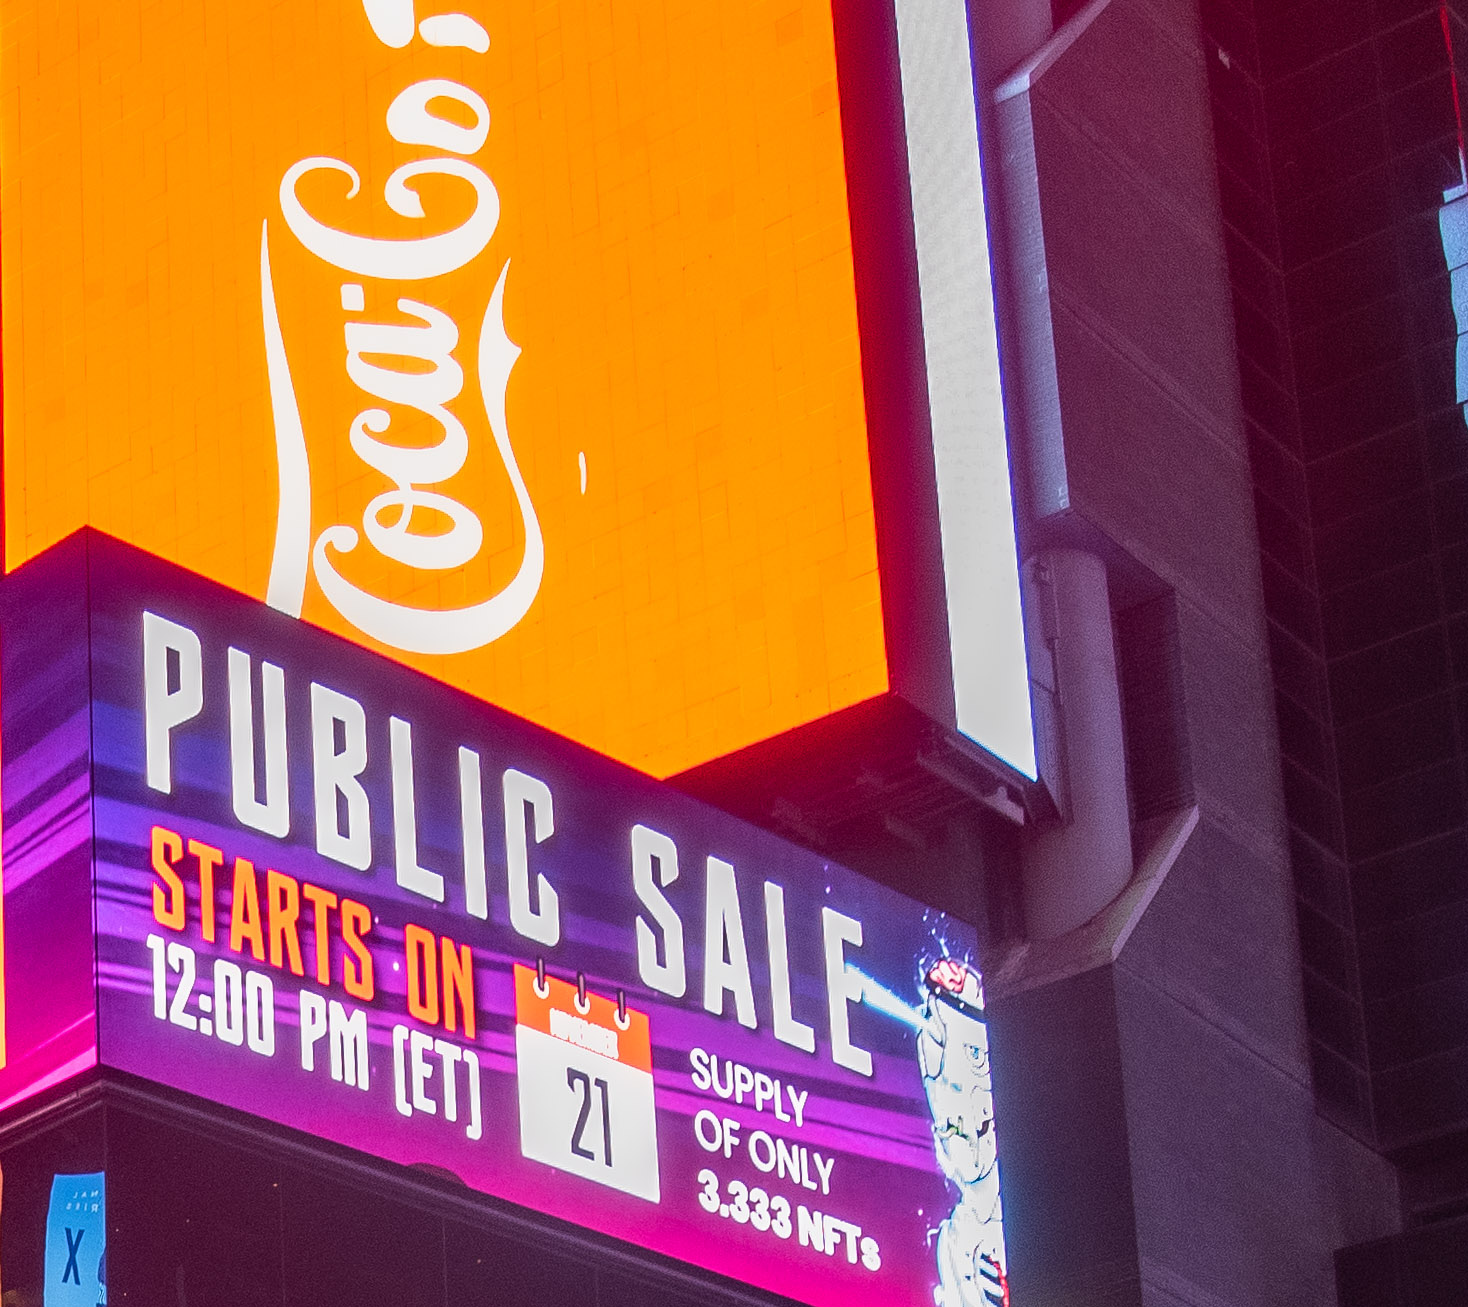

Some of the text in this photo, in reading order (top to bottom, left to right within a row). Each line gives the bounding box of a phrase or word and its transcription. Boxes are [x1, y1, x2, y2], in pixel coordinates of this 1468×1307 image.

[144, 611, 873, 1078] PUBLIC SALE
[151, 826, 476, 1039] STARTS ON
[146, 936, 275, 1055] 12:00
[301, 992, 369, 1091] PM
[567, 1067, 612, 1167] 21
[691, 1048, 808, 1127] SUPPLY
[694, 1112, 835, 1195] OF ONLY
[698, 1169, 881, 1272] 3.333 NFTs
